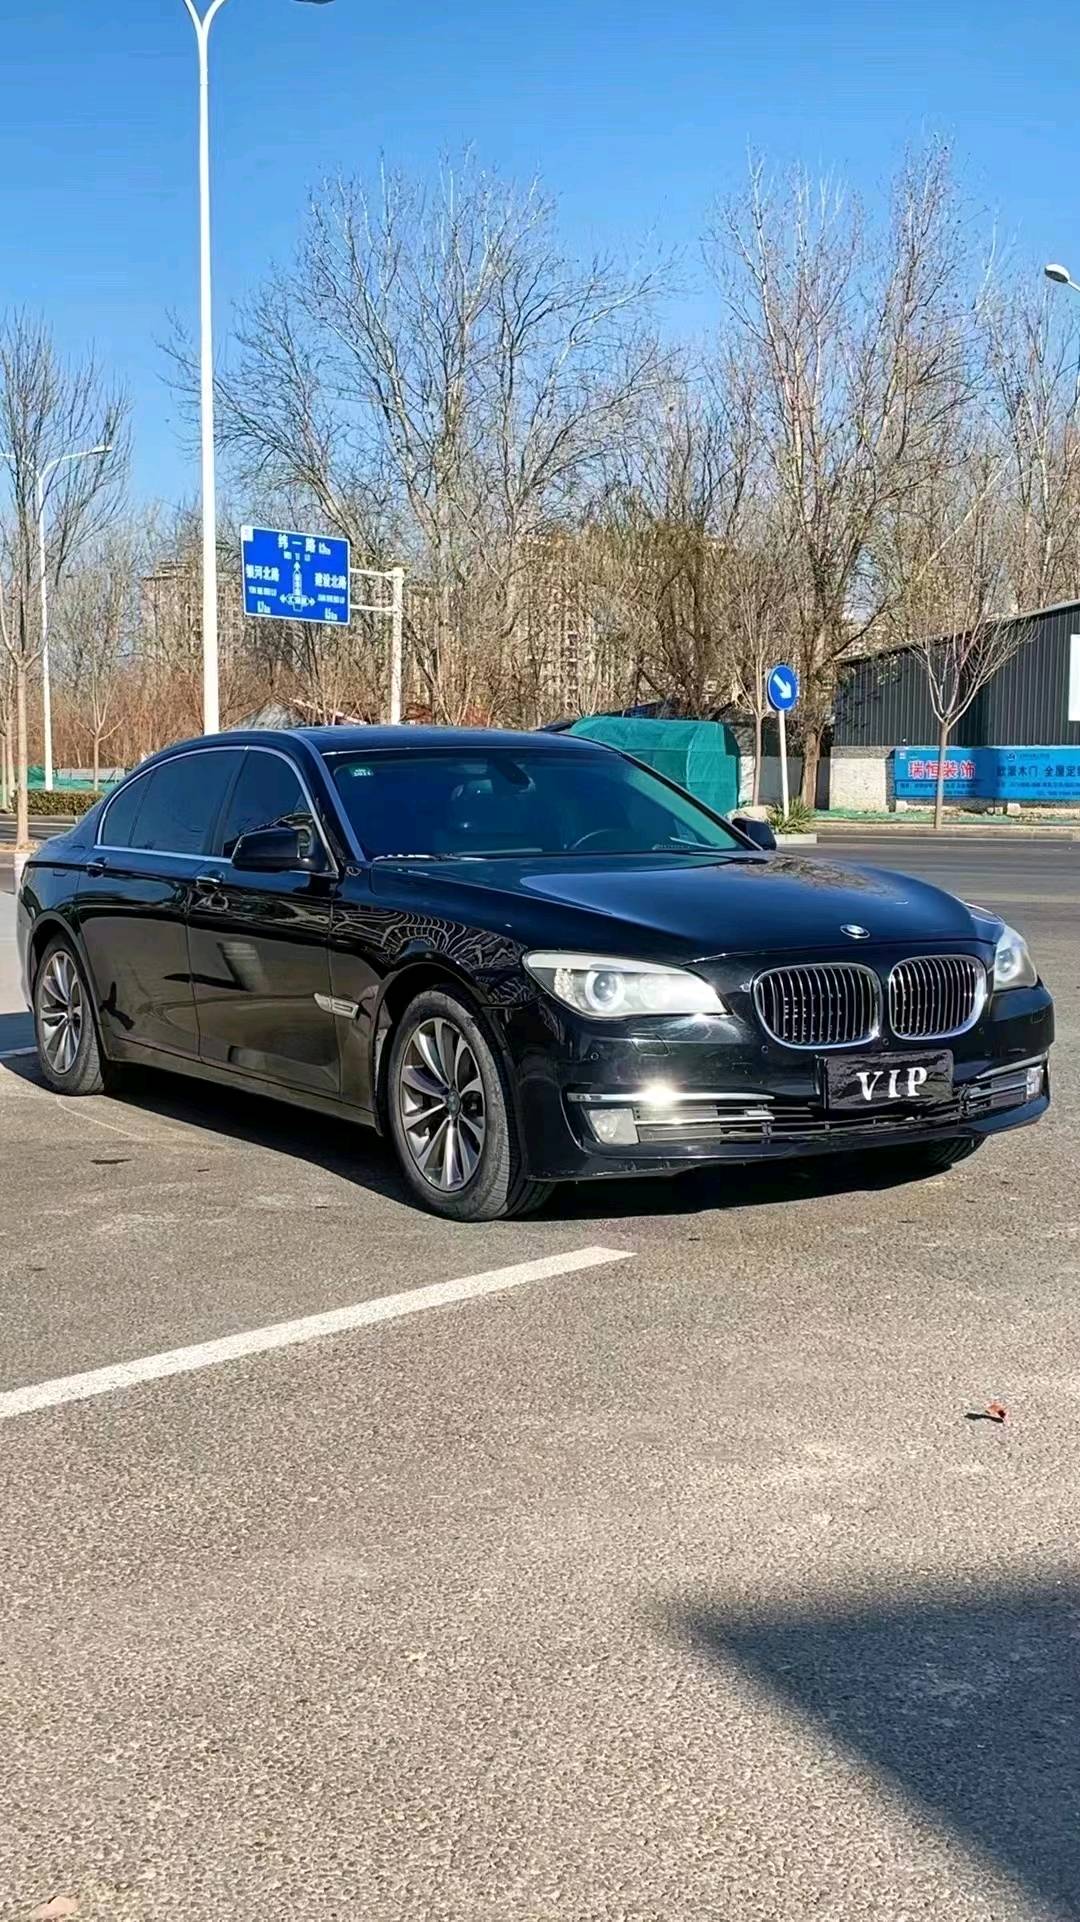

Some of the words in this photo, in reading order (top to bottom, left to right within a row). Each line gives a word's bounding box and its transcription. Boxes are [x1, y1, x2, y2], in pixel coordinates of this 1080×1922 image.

[907, 760, 977, 780] 瑞恒装饰
[856, 1066, 928, 1101] VIP
